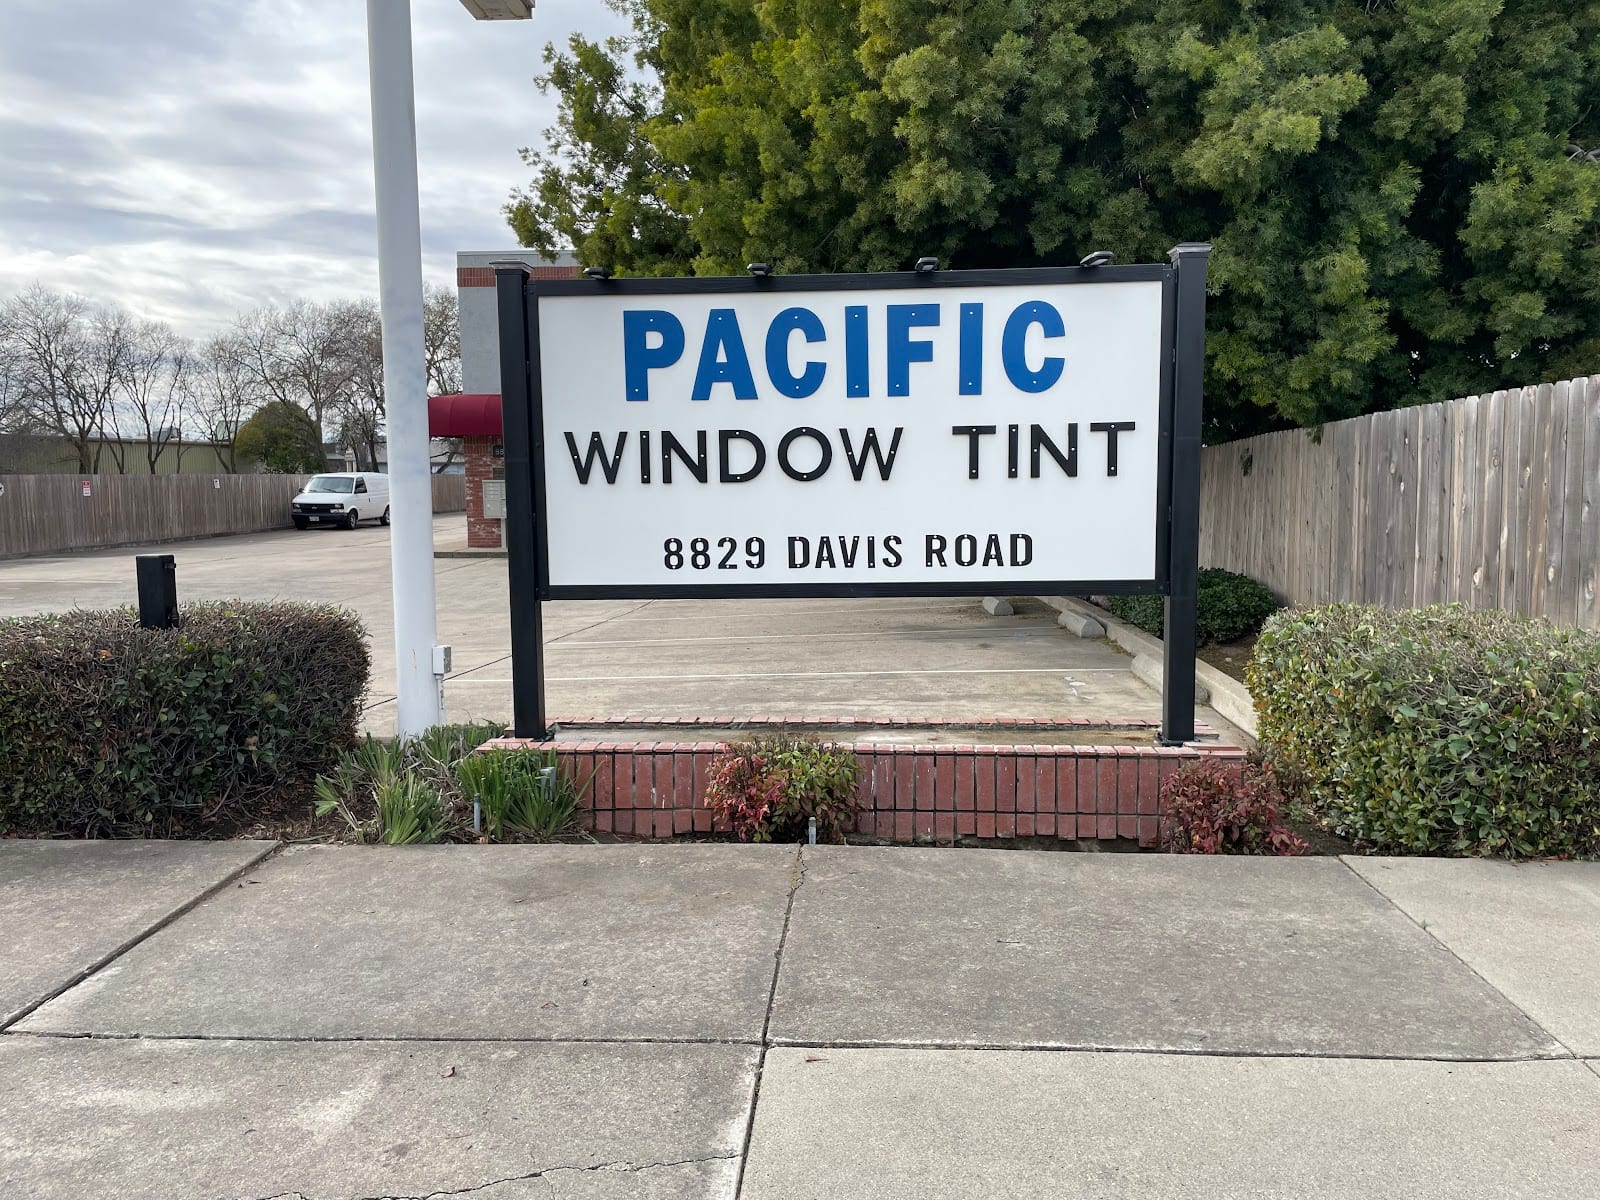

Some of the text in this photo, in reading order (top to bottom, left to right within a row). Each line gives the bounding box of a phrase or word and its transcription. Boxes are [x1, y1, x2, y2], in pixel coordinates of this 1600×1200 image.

[622, 301, 1066, 402] PACIFIC
[563, 421, 1137, 486] WINDOW TINT
[663, 533, 1033, 571] 8829 DAVIS ROAD
